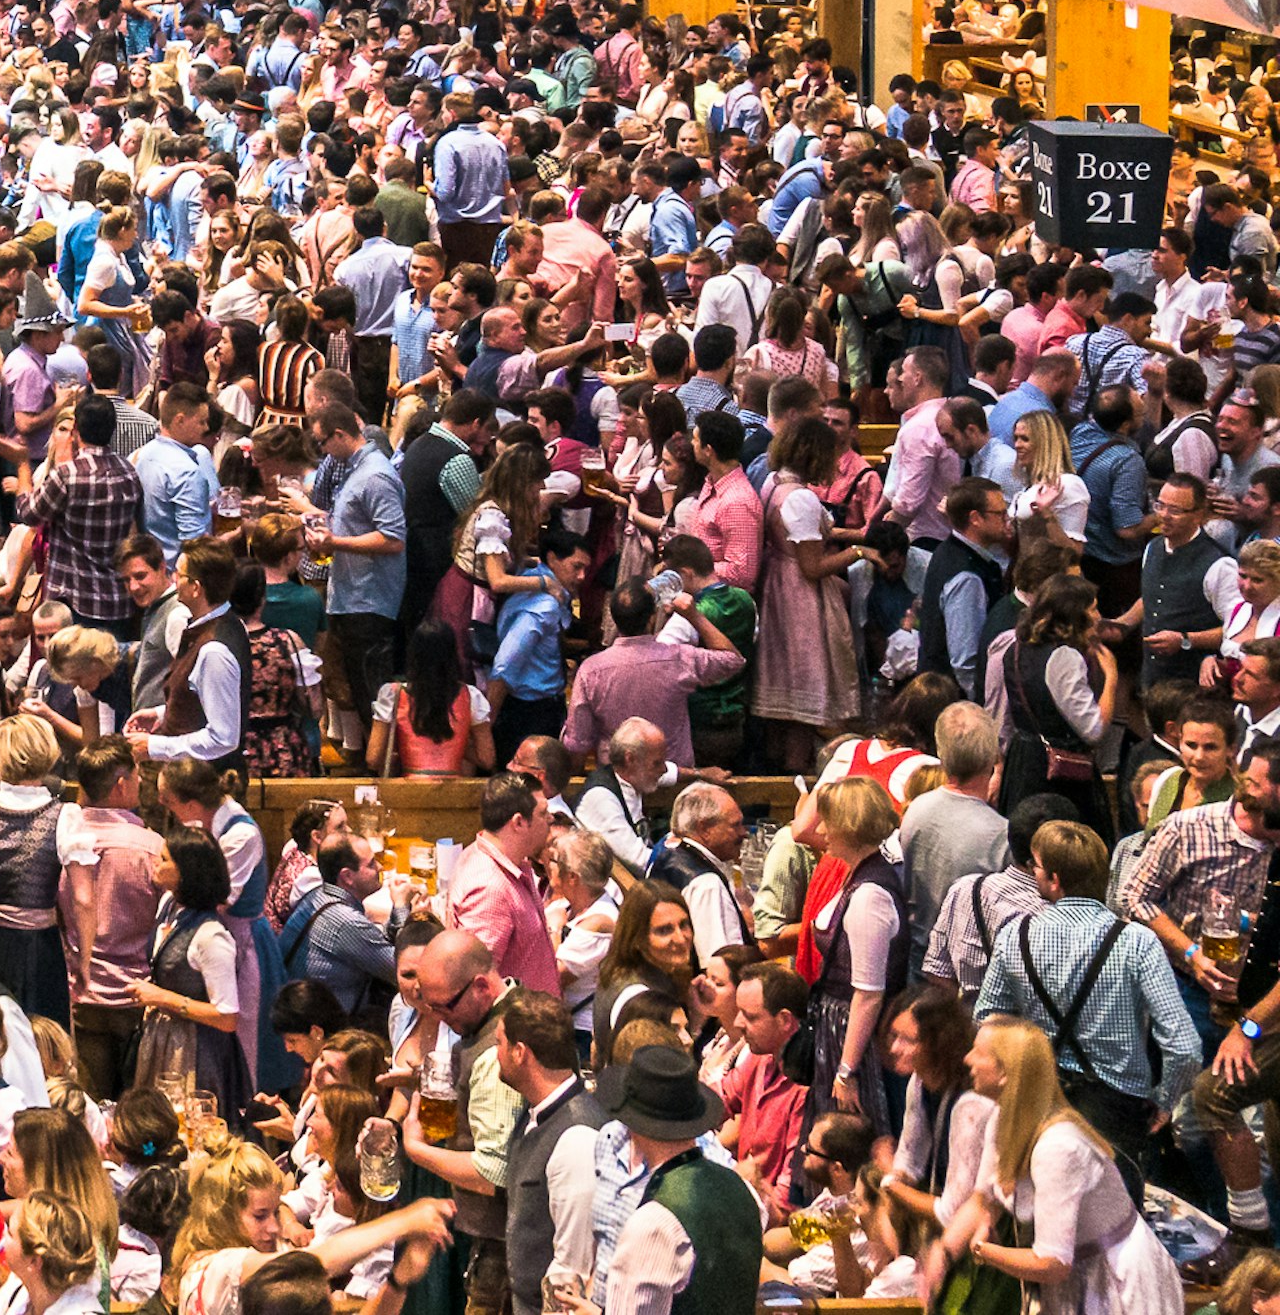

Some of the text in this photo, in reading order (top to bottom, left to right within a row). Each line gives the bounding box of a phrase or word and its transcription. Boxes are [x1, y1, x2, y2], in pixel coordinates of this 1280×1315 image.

[1032, 140, 1054, 175] Boxe
[1076, 152, 1151, 181] Boxe
[1037, 181, 1054, 218] 21
[1085, 190, 1137, 224] 21
